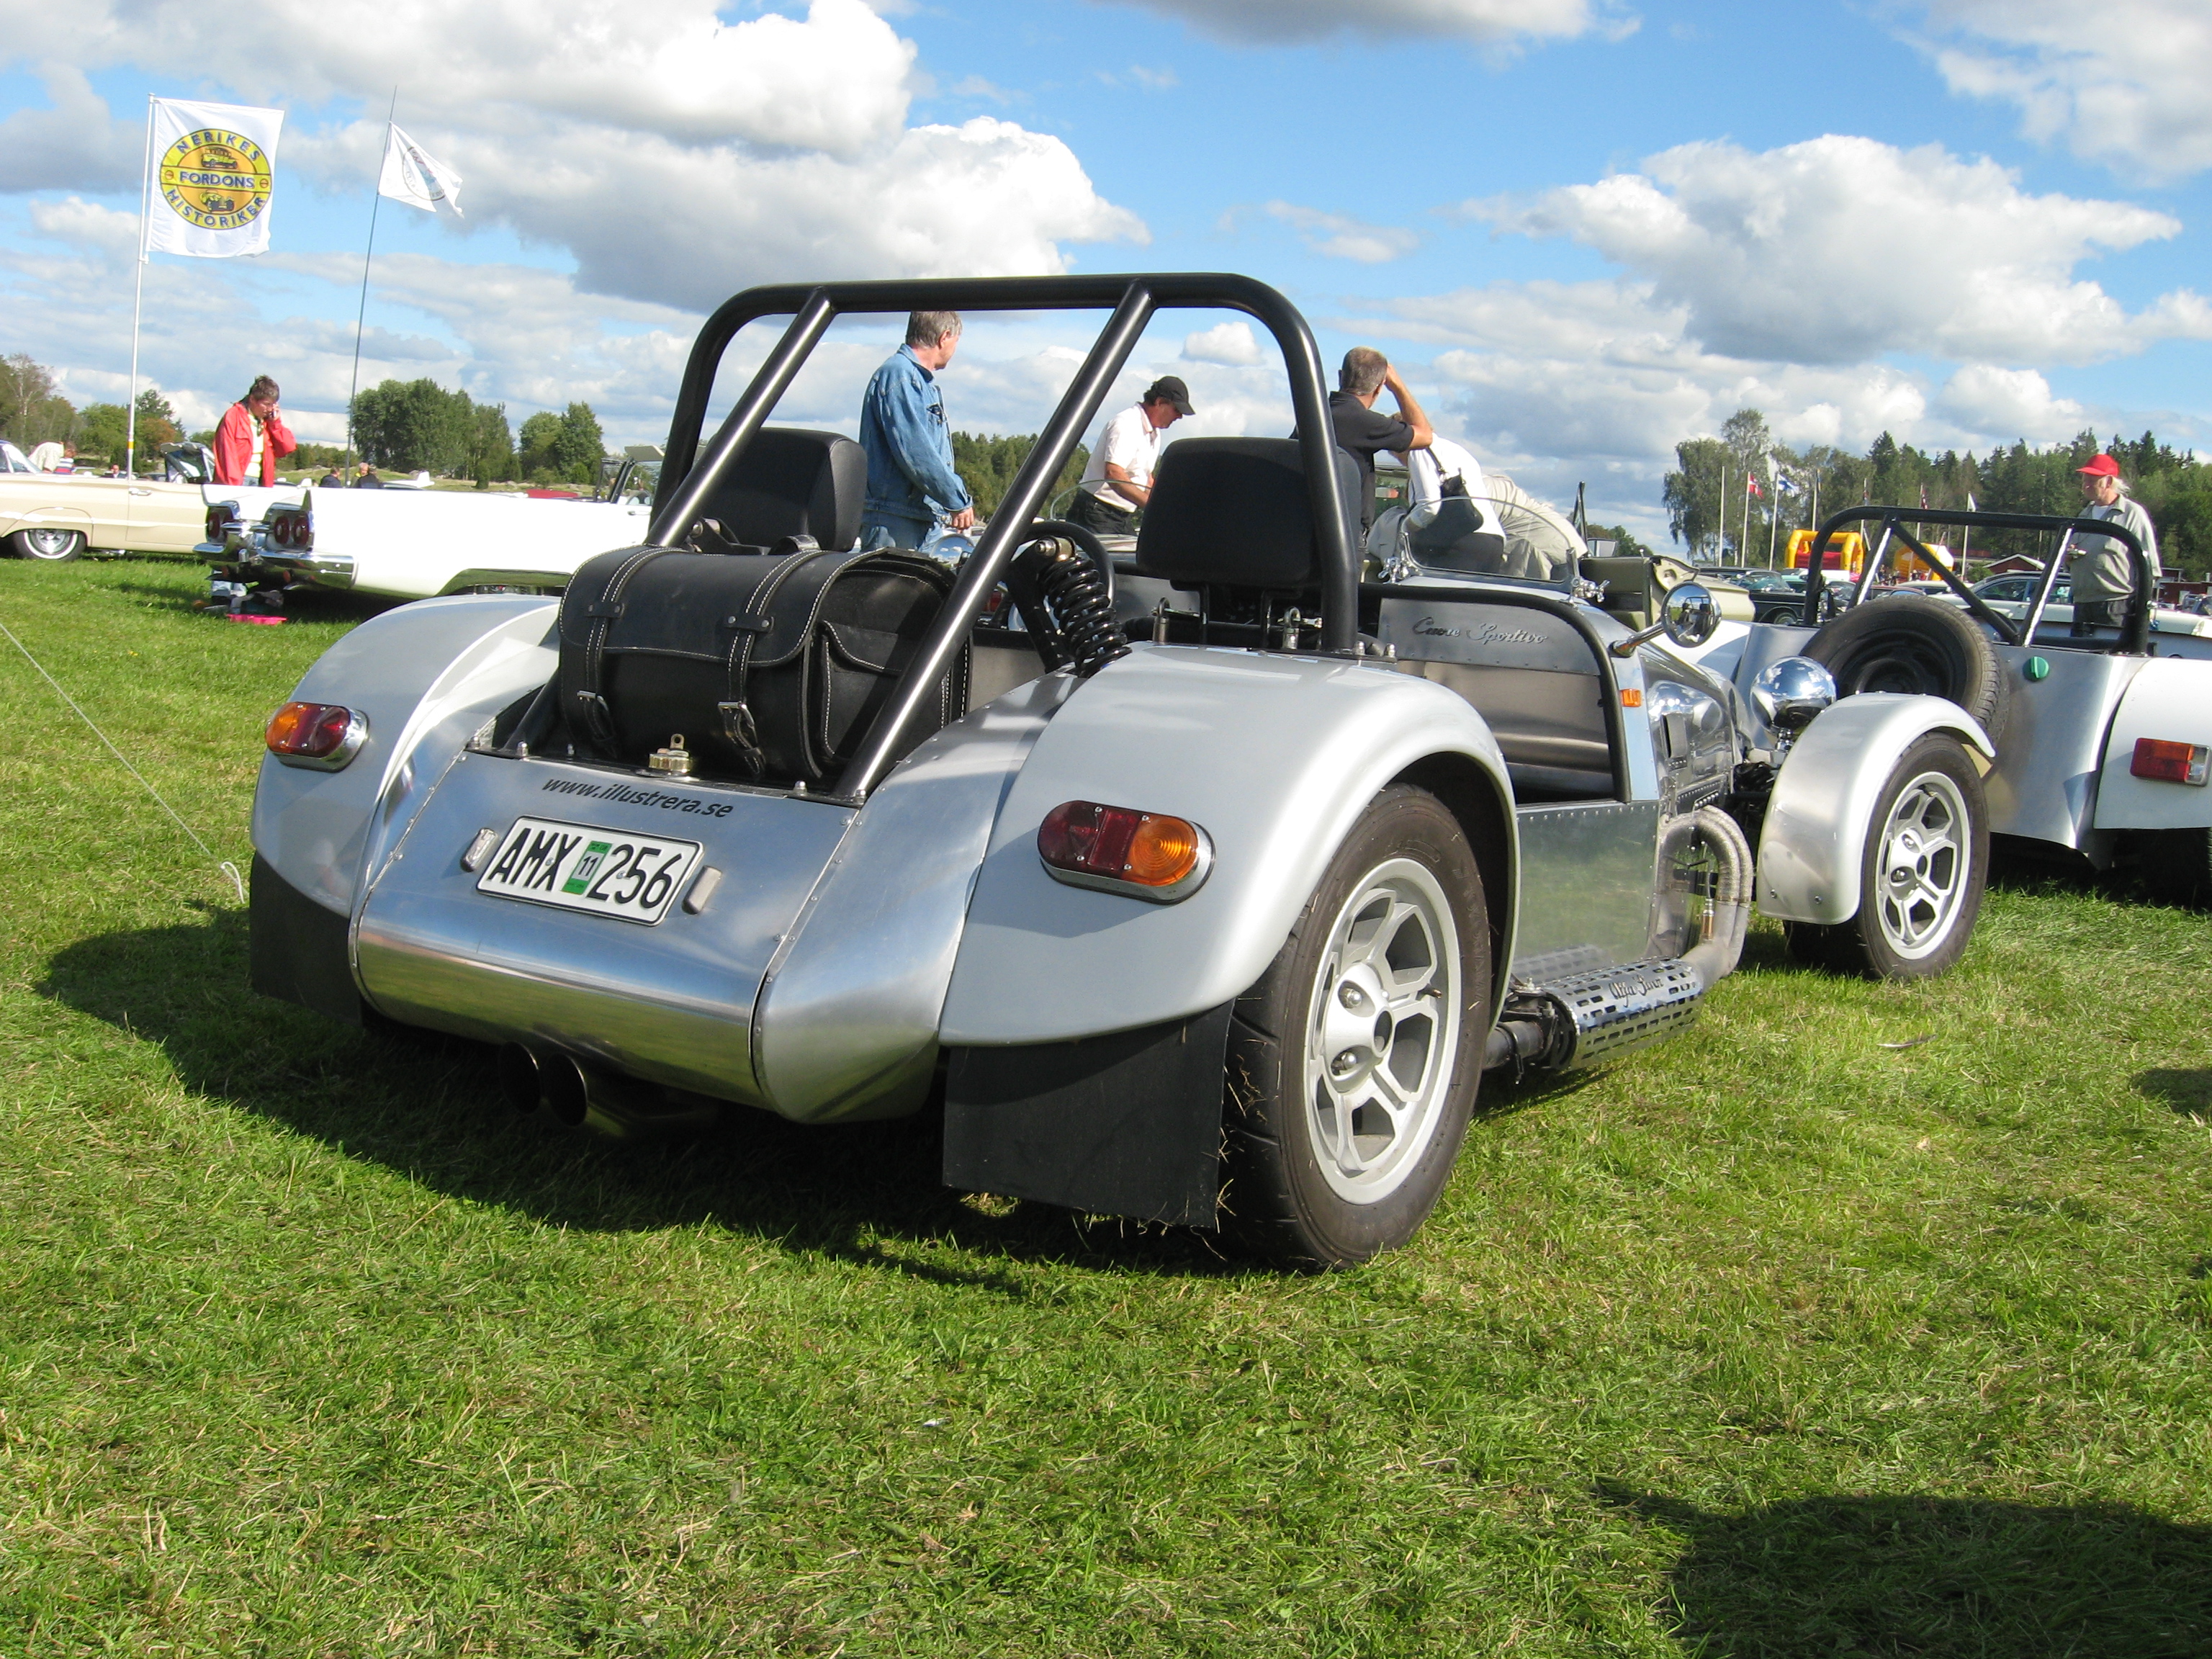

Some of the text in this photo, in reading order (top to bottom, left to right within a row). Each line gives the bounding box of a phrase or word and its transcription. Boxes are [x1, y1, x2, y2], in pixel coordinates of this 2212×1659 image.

[176, 131, 260, 161] NERIKES
[180, 171, 256, 189] FORDONS
[167, 189, 266, 227] HISTORIKER
[1466, 623, 1549, 645] Sportivo
[542, 778, 734, 818] www.illustrera.se
[487, 827, 683, 909] AMX 11 256
